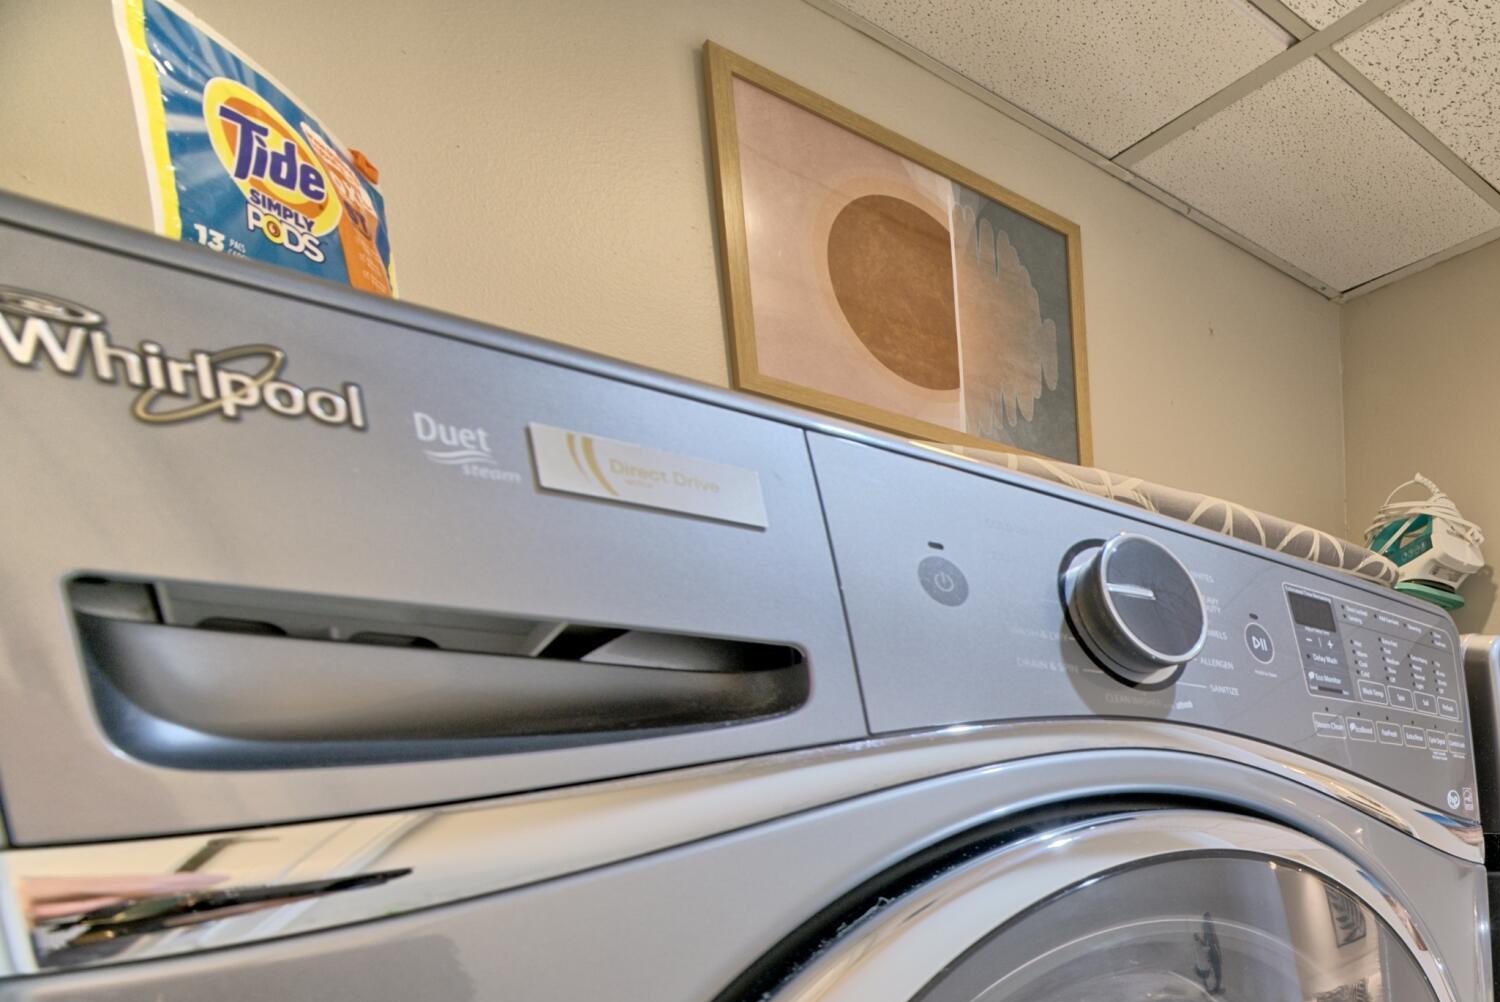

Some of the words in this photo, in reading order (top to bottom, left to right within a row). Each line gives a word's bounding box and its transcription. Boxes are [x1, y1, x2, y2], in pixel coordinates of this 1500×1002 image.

[219, 105, 325, 202] Tide
[249, 188, 315, 232] SIMPLY
[193, 223, 226, 253] 13
[246, 200, 326, 263] PODS
[0, 311, 366, 429] Whirlpool
[413, 411, 491, 451] Duet
[461, 462, 522, 484] steam
[608, 457, 668, 483] Direct
[671, 471, 721, 494] Drive
[1209, 684, 1240, 696] SANITIZE
